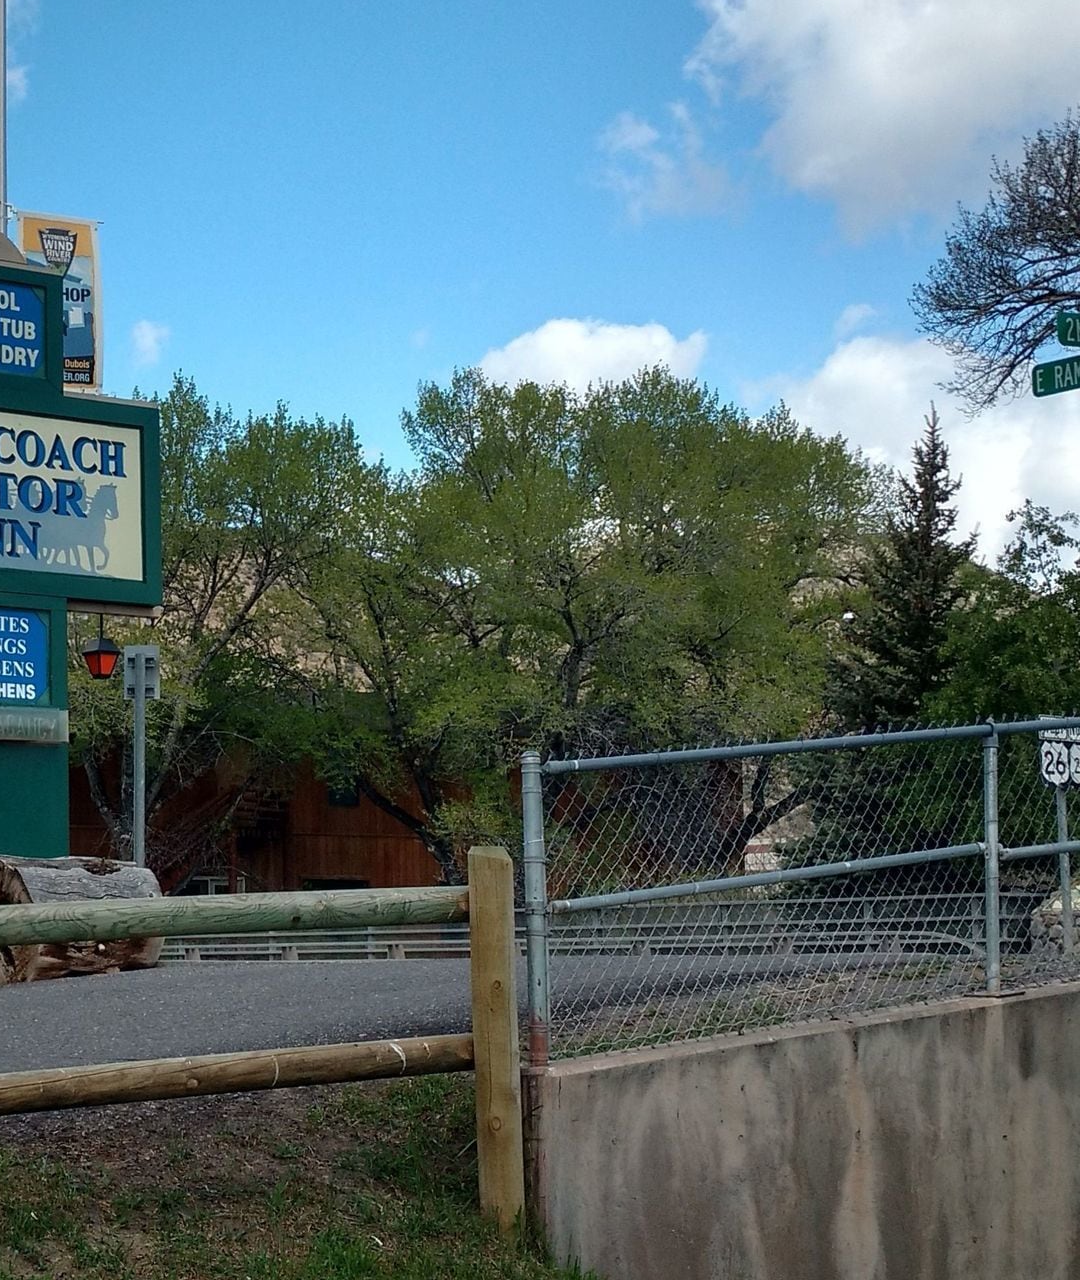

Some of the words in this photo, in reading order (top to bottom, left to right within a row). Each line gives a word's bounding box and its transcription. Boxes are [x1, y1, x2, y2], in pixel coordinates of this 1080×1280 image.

[43, 239, 73, 251] WIND
[46, 249, 71, 258] RIVER
[0, 317, 36, 340] TUB
[64, 359, 90, 369] Dubois
[1036, 369, 1045, 393] E
[1044, 751, 1066, 775] 26
